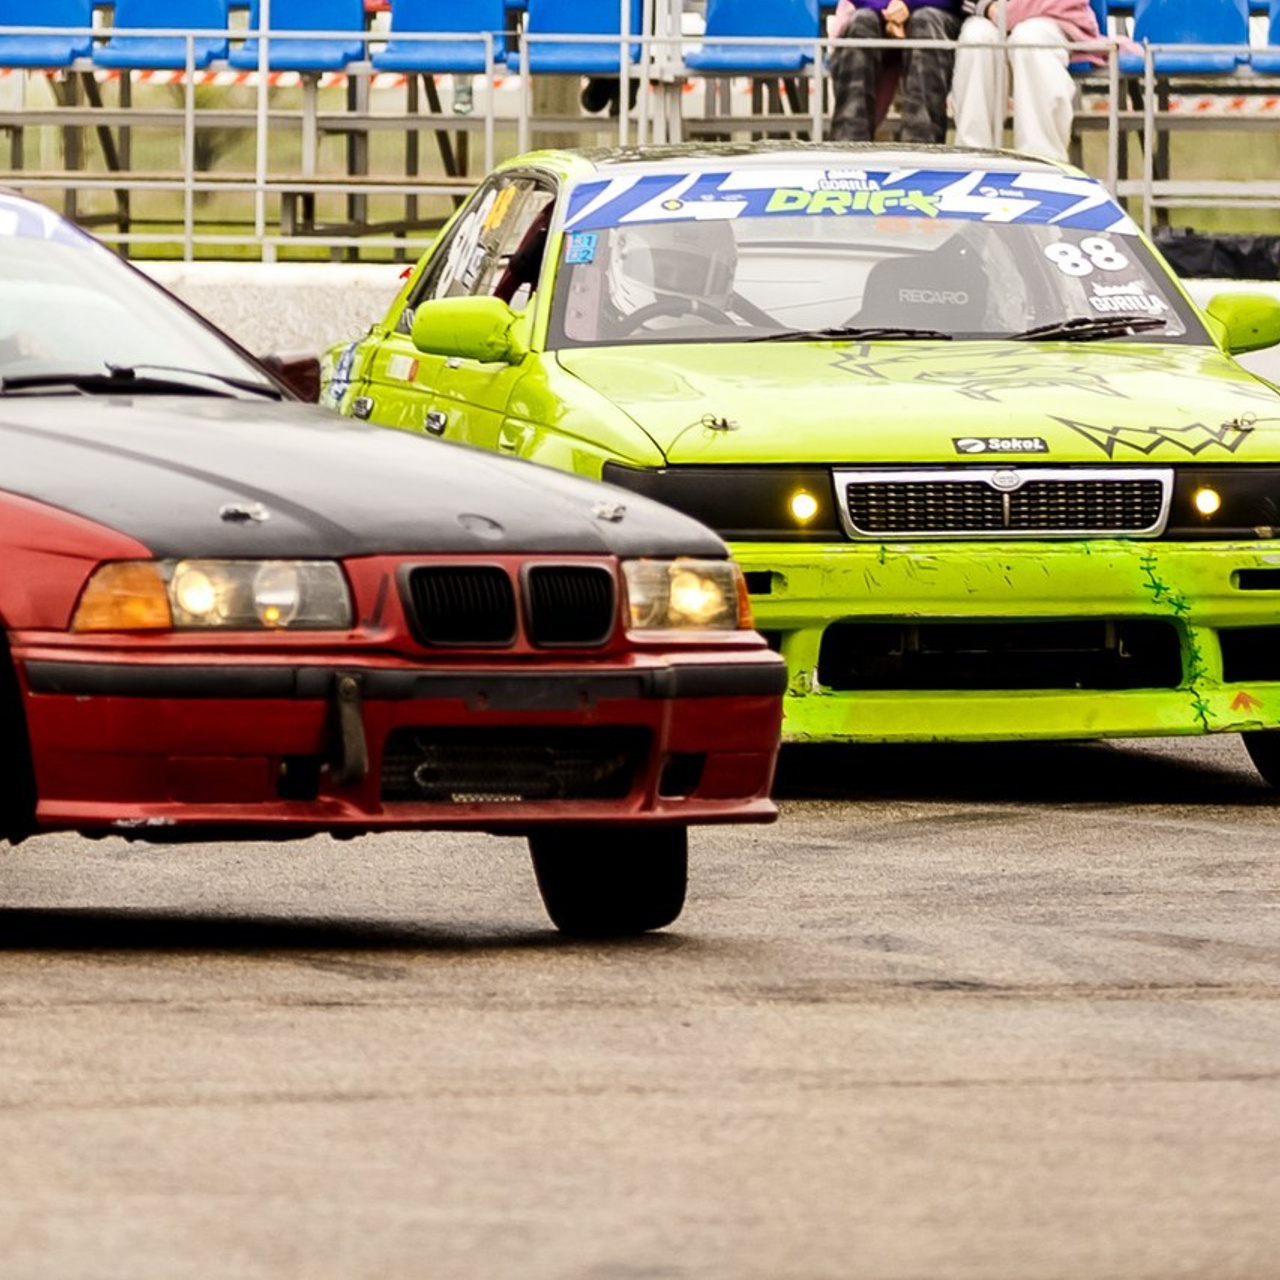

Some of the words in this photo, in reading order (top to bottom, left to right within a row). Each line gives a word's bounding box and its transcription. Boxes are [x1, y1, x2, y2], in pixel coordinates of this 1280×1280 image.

[1044, 236, 1128, 277] 88
[899, 289, 968, 305] RECARO
[1089, 294, 1169, 314] GORILLA
